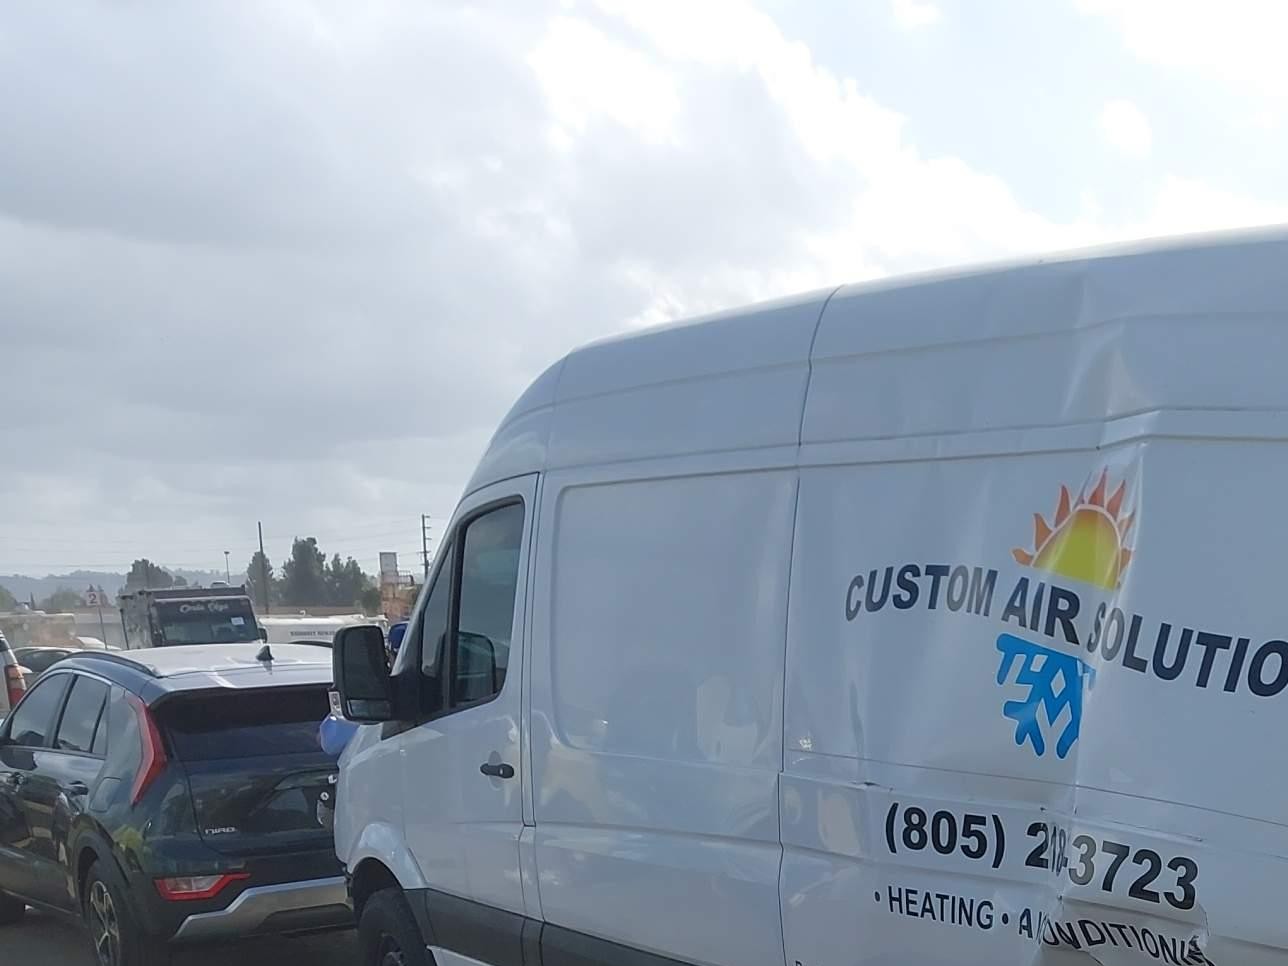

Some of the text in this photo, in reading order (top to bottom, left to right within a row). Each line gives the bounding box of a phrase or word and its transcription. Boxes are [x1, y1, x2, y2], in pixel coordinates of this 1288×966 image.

[845, 563, 998, 622] CUSTOM
[1001, 576, 1080, 646] AIR
[885, 802, 1005, 869] (805)
[888, 885, 994, 930] HEATING
